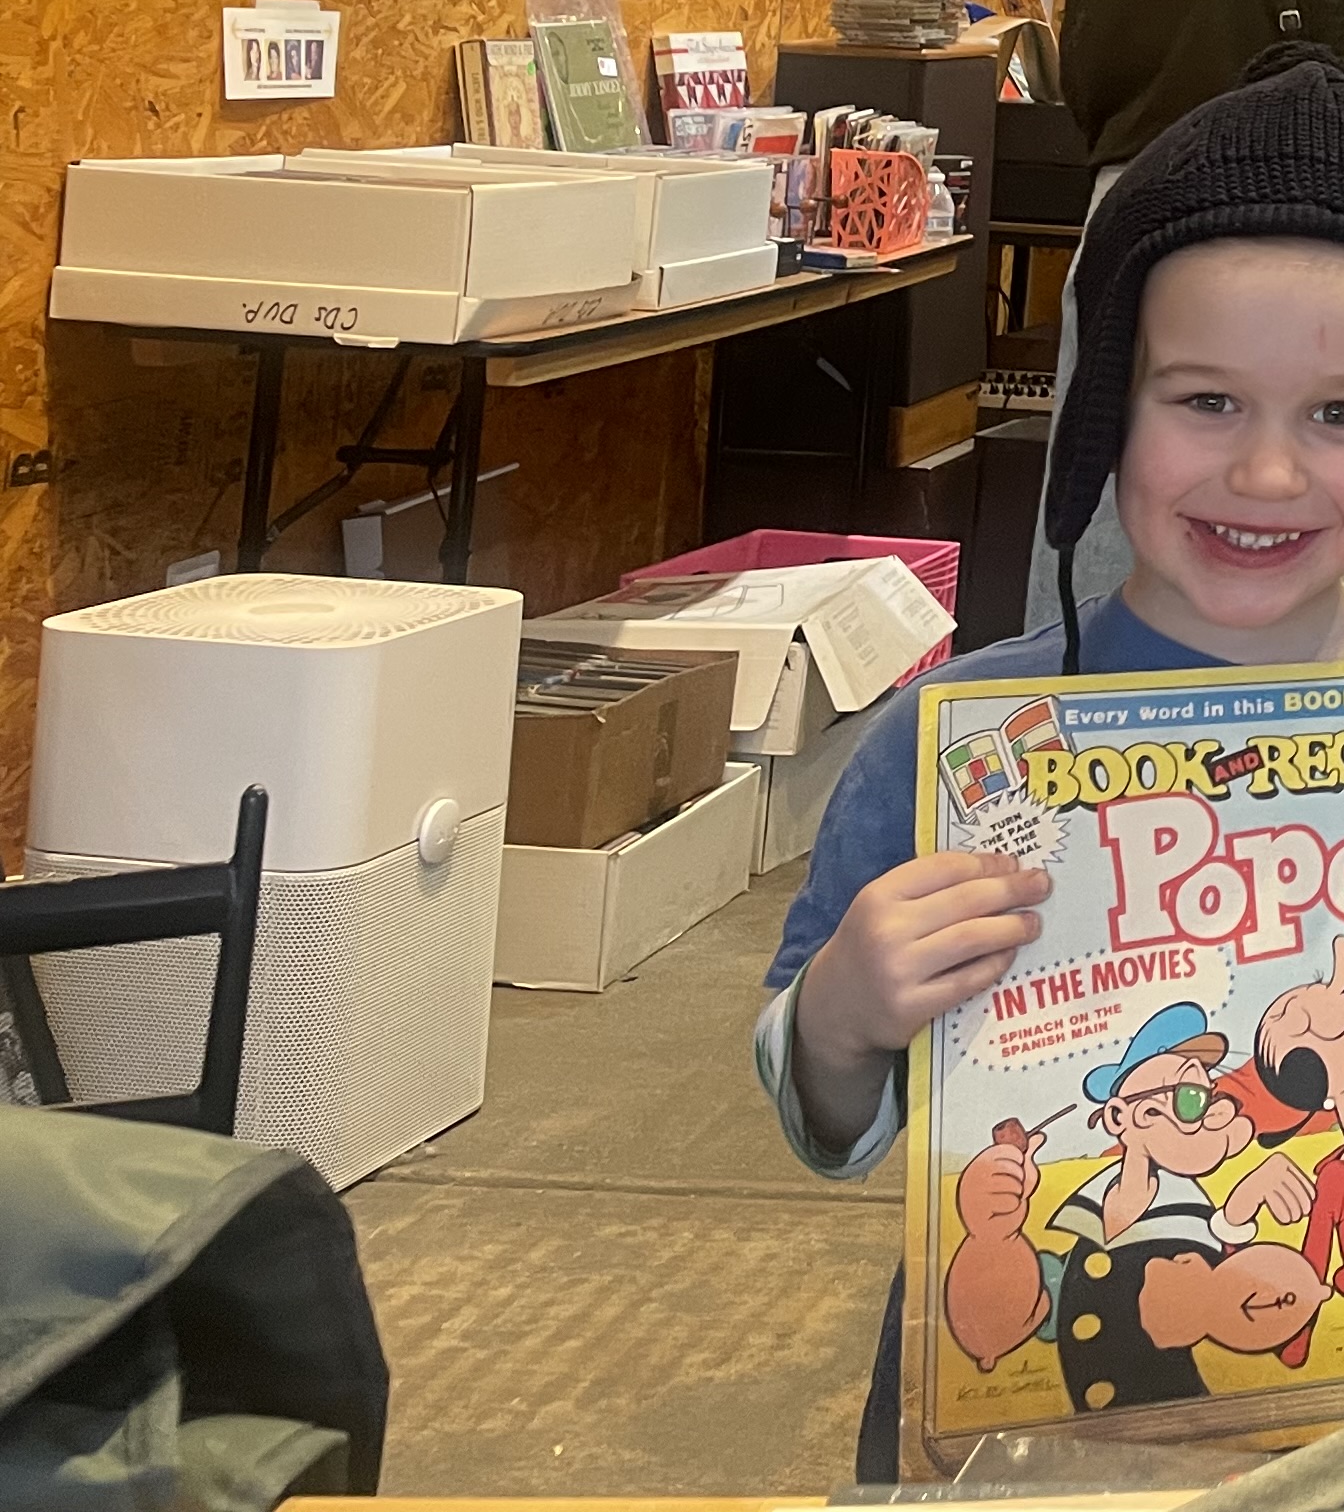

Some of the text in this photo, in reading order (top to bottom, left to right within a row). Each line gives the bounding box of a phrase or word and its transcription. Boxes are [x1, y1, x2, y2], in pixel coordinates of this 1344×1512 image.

[1065, 708, 1129, 725] Every
[1203, 700, 1224, 717] in
[1233, 698, 1275, 715] this
[1022, 739, 1229, 808] BOOK
[1212, 748, 1261, 784] AND
[980, 815, 1042, 849] THE PAGE
[989, 812, 1023, 832] TURN
[1013, 829, 1038, 846] THE
[992, 947, 1197, 1021] IN THE MOVIES
[999, 1003, 1123, 1045] SPINACH ON THE
[1001, 1020, 1110, 1059] SPANISH MAIN
